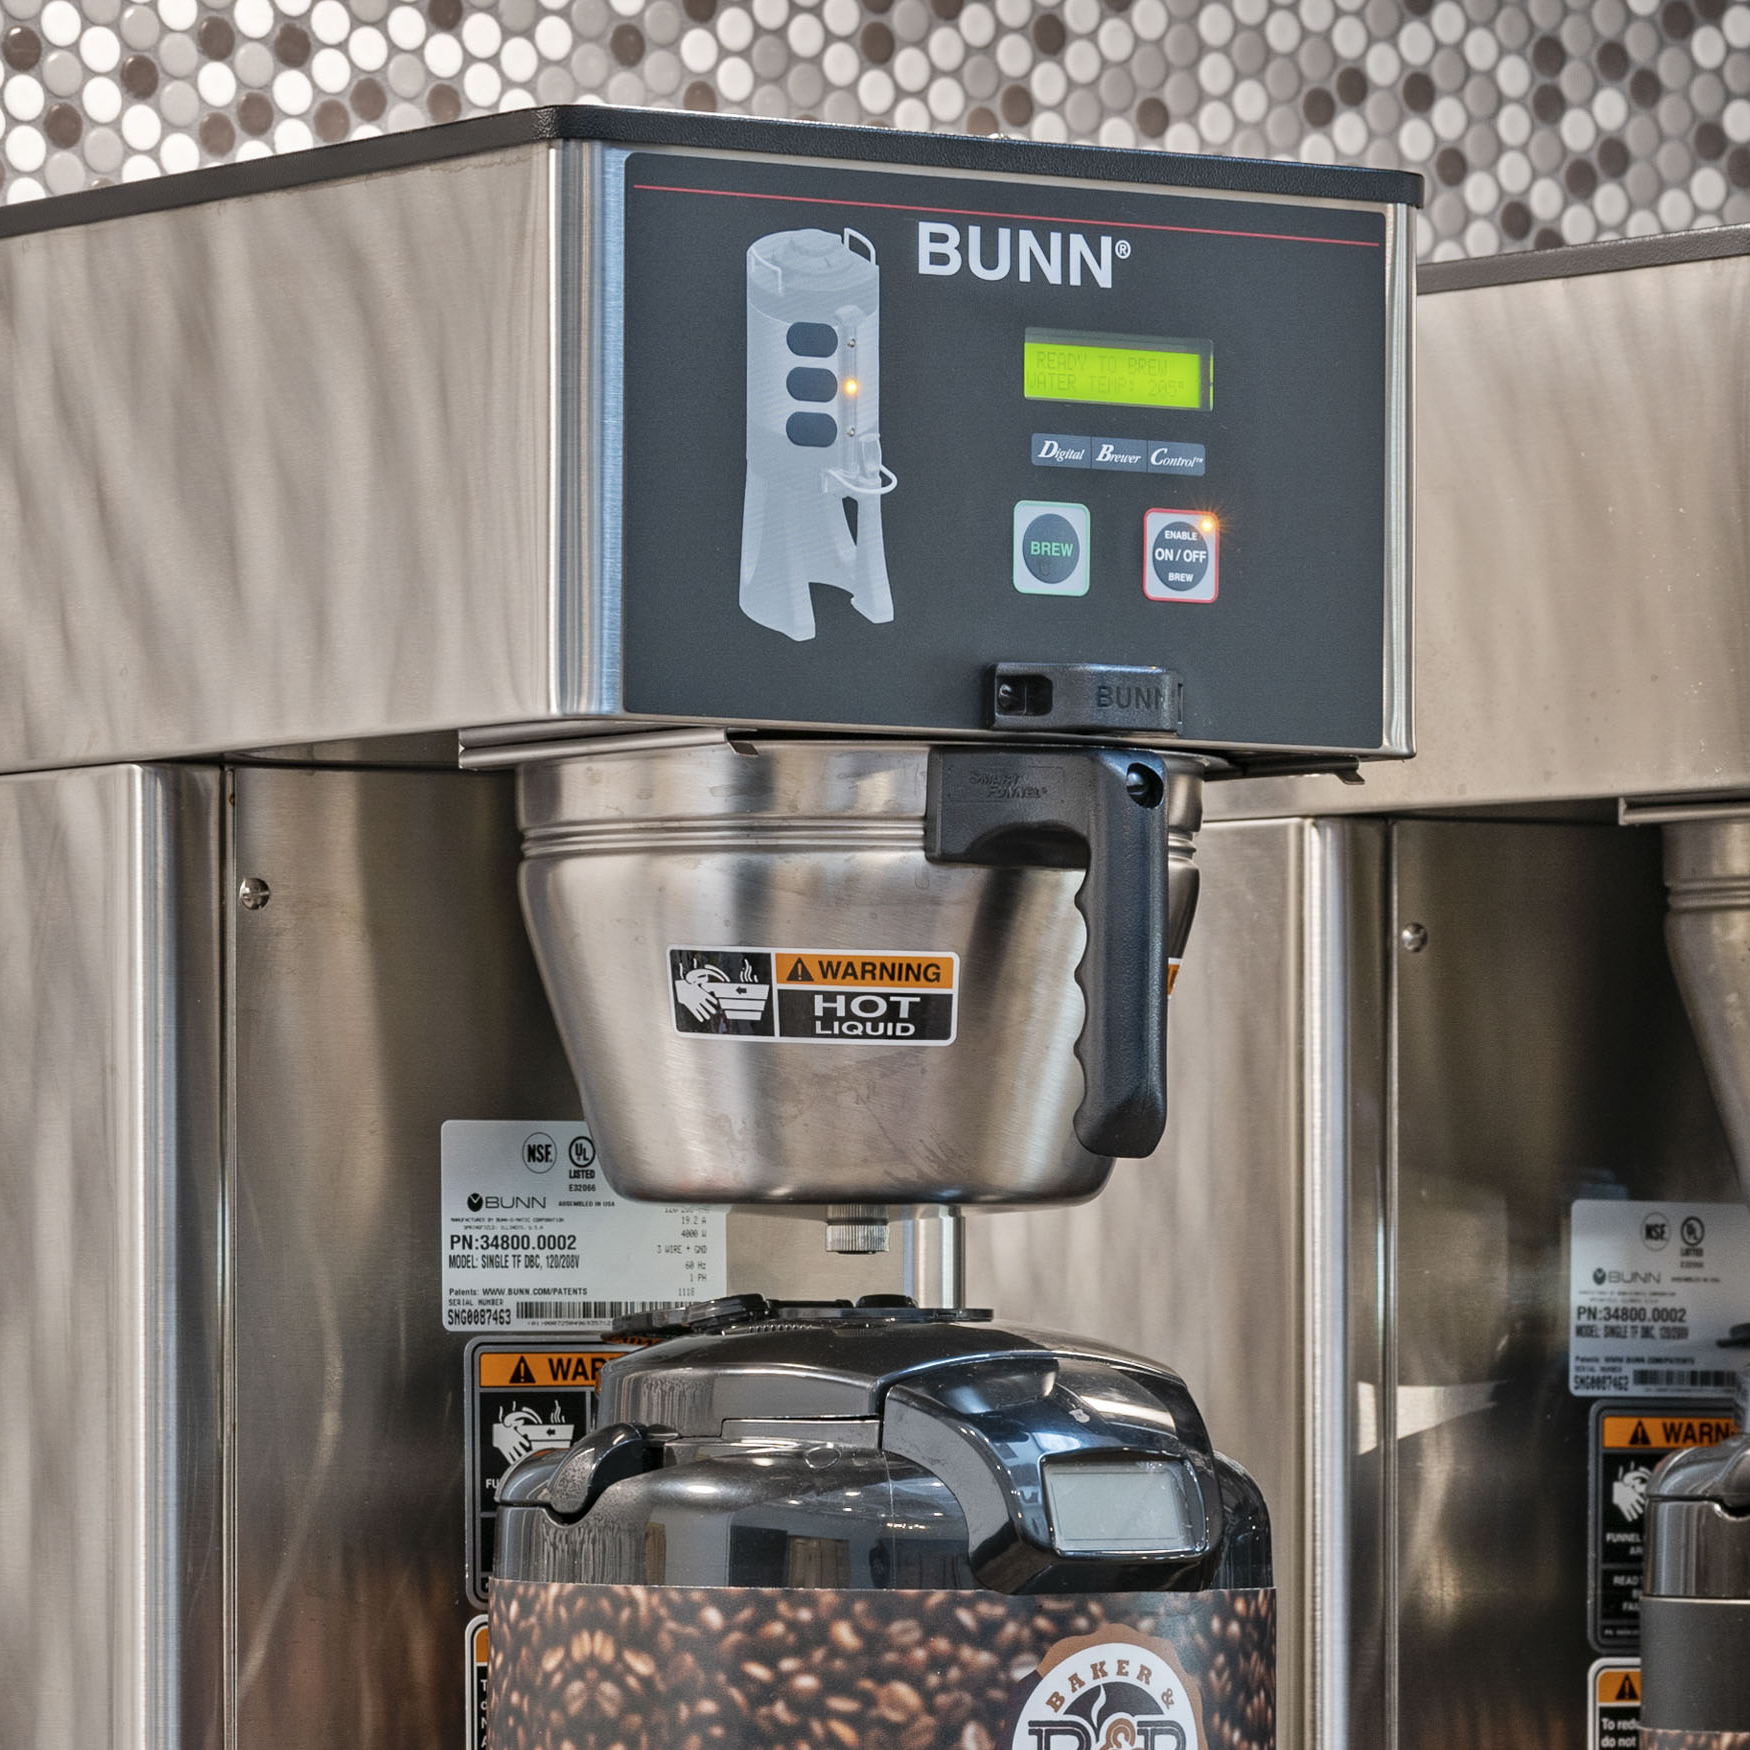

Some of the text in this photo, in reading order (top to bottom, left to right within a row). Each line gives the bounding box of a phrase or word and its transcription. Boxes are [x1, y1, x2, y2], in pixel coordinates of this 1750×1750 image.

[1035, 350, 1087, 371] READY
[1097, 354, 1117, 374] TO
[1037, 439, 1086, 462] Digital
[1095, 443, 1142, 465] Brewer
[1164, 529, 1198, 542] ENABLE
[1030, 540, 1074, 558] BREW
[1167, 571, 1194, 583] BREW
[817, 959, 942, 983] WARNING
[813, 993, 921, 1019] HOT
[814, 1020, 916, 1037] LIQUID
[568, 1168, 596, 1180] LISTED
[484, 1196, 547, 1210] BUNN
[449, 1233, 577, 1251] PN:34800.0002
[448, 1254, 479, 1269] MODEL:
[481, 1254, 510, 1269] SINGLE
[511, 1255, 522, 1269] TF
[1607, 1270, 1662, 1284] BUNN
[1576, 1305, 1687, 1323] PN:34800.0002
[1045, 1658, 1154, 1714] BAKER
[1600, 1717, 1616, 1731] To
[1600, 1735, 1616, 1748] do
